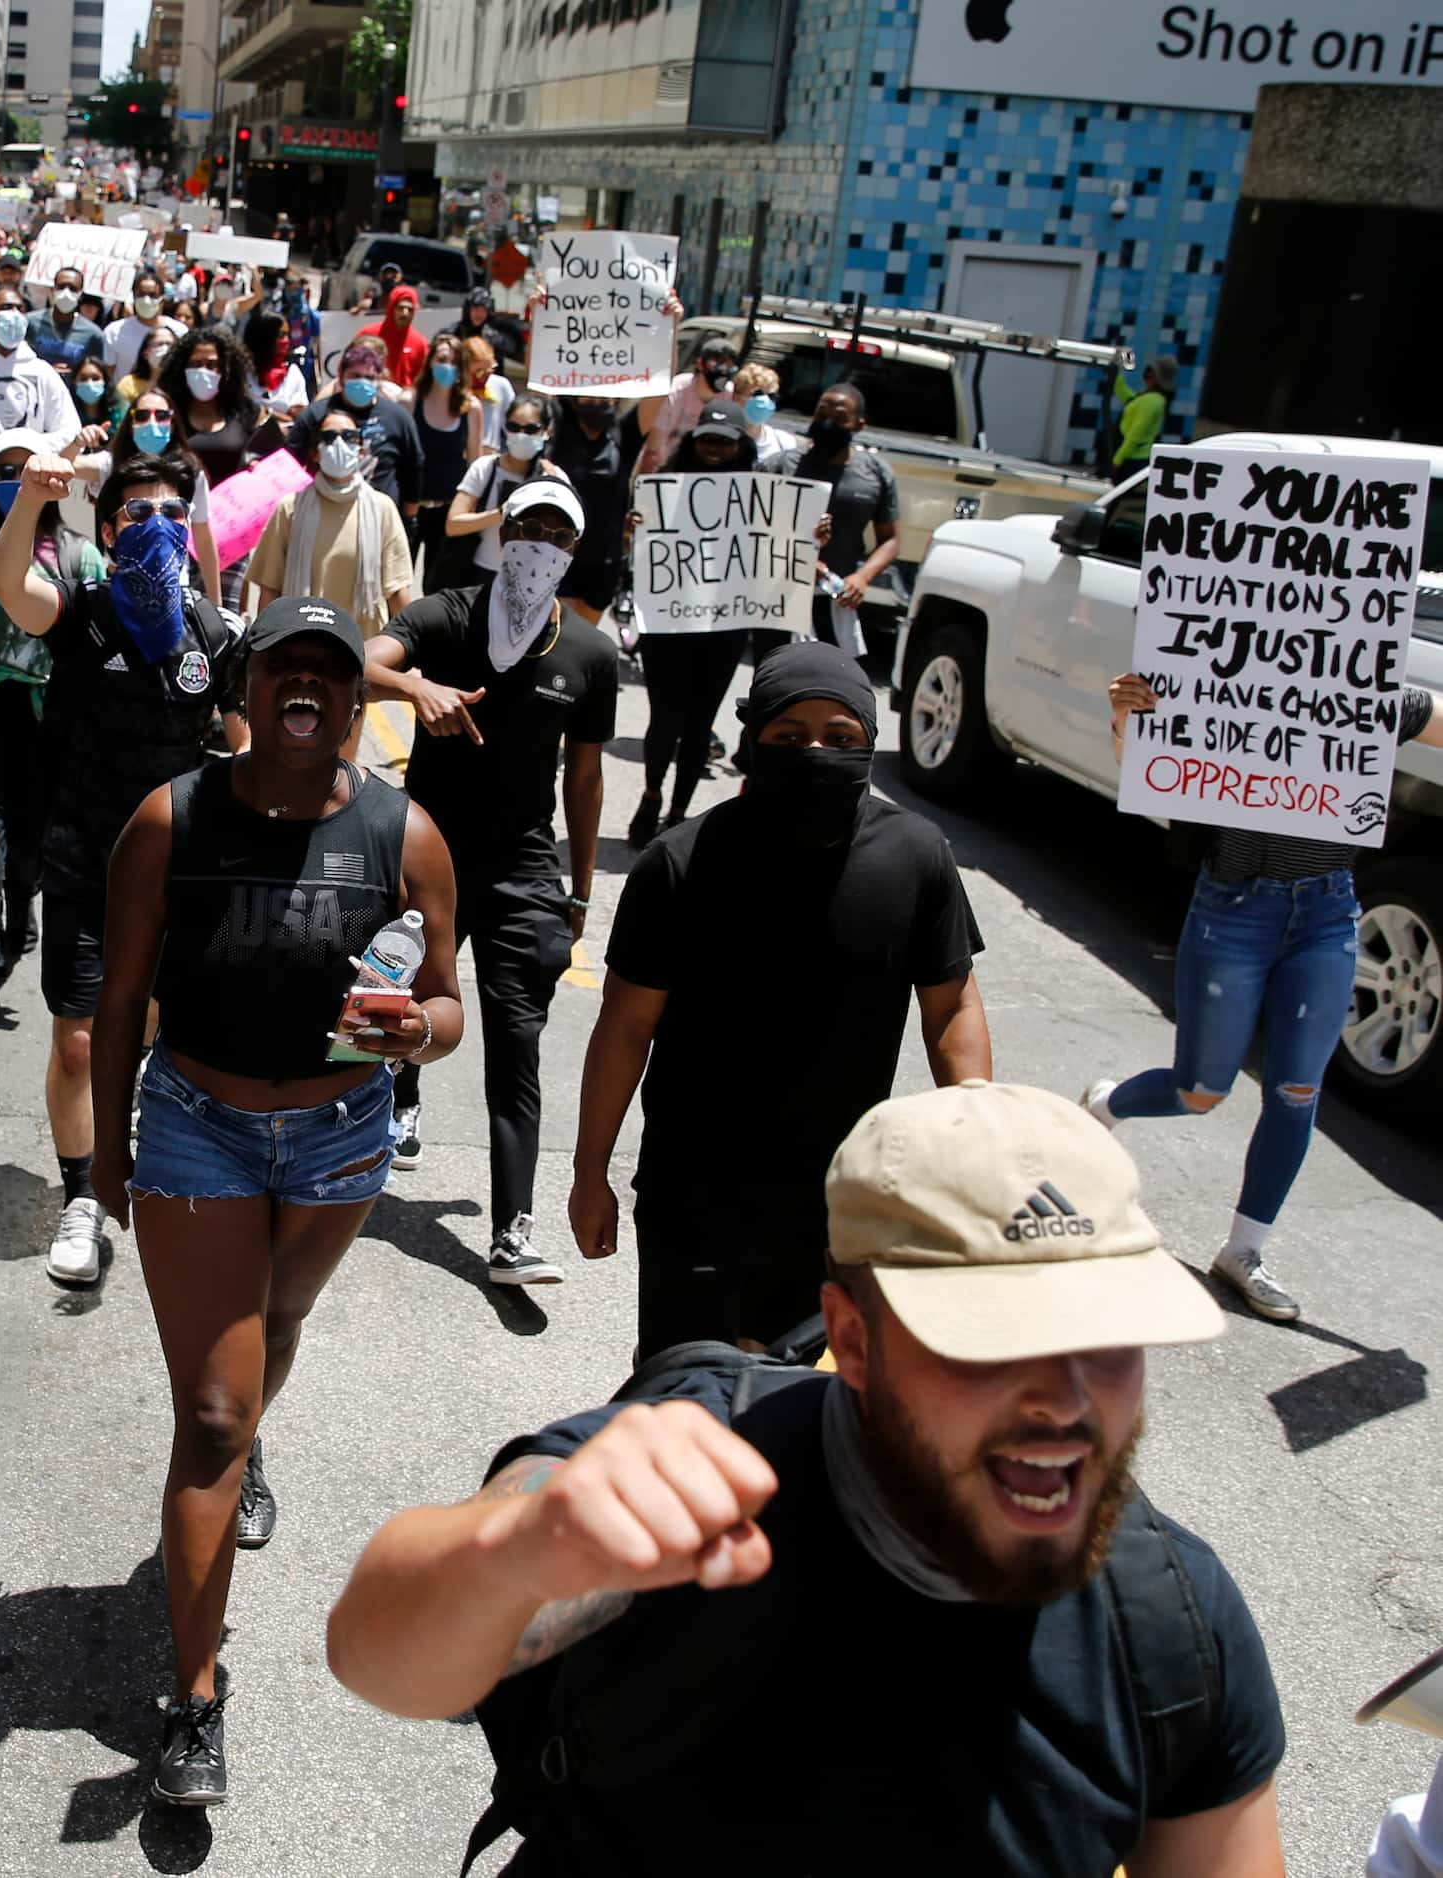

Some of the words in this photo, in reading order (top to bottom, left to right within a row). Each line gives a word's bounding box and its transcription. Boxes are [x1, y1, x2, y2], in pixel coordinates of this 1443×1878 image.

[1157, 5, 1298, 66] Shot
[1312, 29, 1385, 73] on
[551, 236, 599, 280] You
[545, 282, 602, 311] have
[608, 288, 631, 308] to
[641, 287, 667, 312] be
[557, 344, 579, 364] to
[589, 344, 635, 367] feel
[689, 477, 814, 532] CAN'T
[1154, 455, 1223, 500] IF
[1239, 462, 1339, 524] YOU
[1334, 479, 1418, 530] ARE
[650, 532, 814, 594] BREATHE
[1145, 511, 1352, 580] NEUTRAL
[1355, 540, 1413, 582] IN
[733, 594, 786, 621] Floyd
[1146, 564, 1351, 624] SITUATIONS
[1362, 588, 1409, 626] OF
[1157, 611, 1400, 692] INJUSTICE
[1138, 670, 1182, 699] YOU
[1194, 678, 1274, 711] HAVE
[1279, 685, 1398, 734] CHOSEN
[1131, 708, 1192, 748] THE
[1204, 715, 1260, 755] SIDE
[1264, 726, 1308, 767] OF
[1319, 733, 1380, 776] THE
[1145, 755, 1341, 818] OPPRESSOR
[229, 882, 344, 951] USA
[1003, 1215, 1095, 1242] adidas
